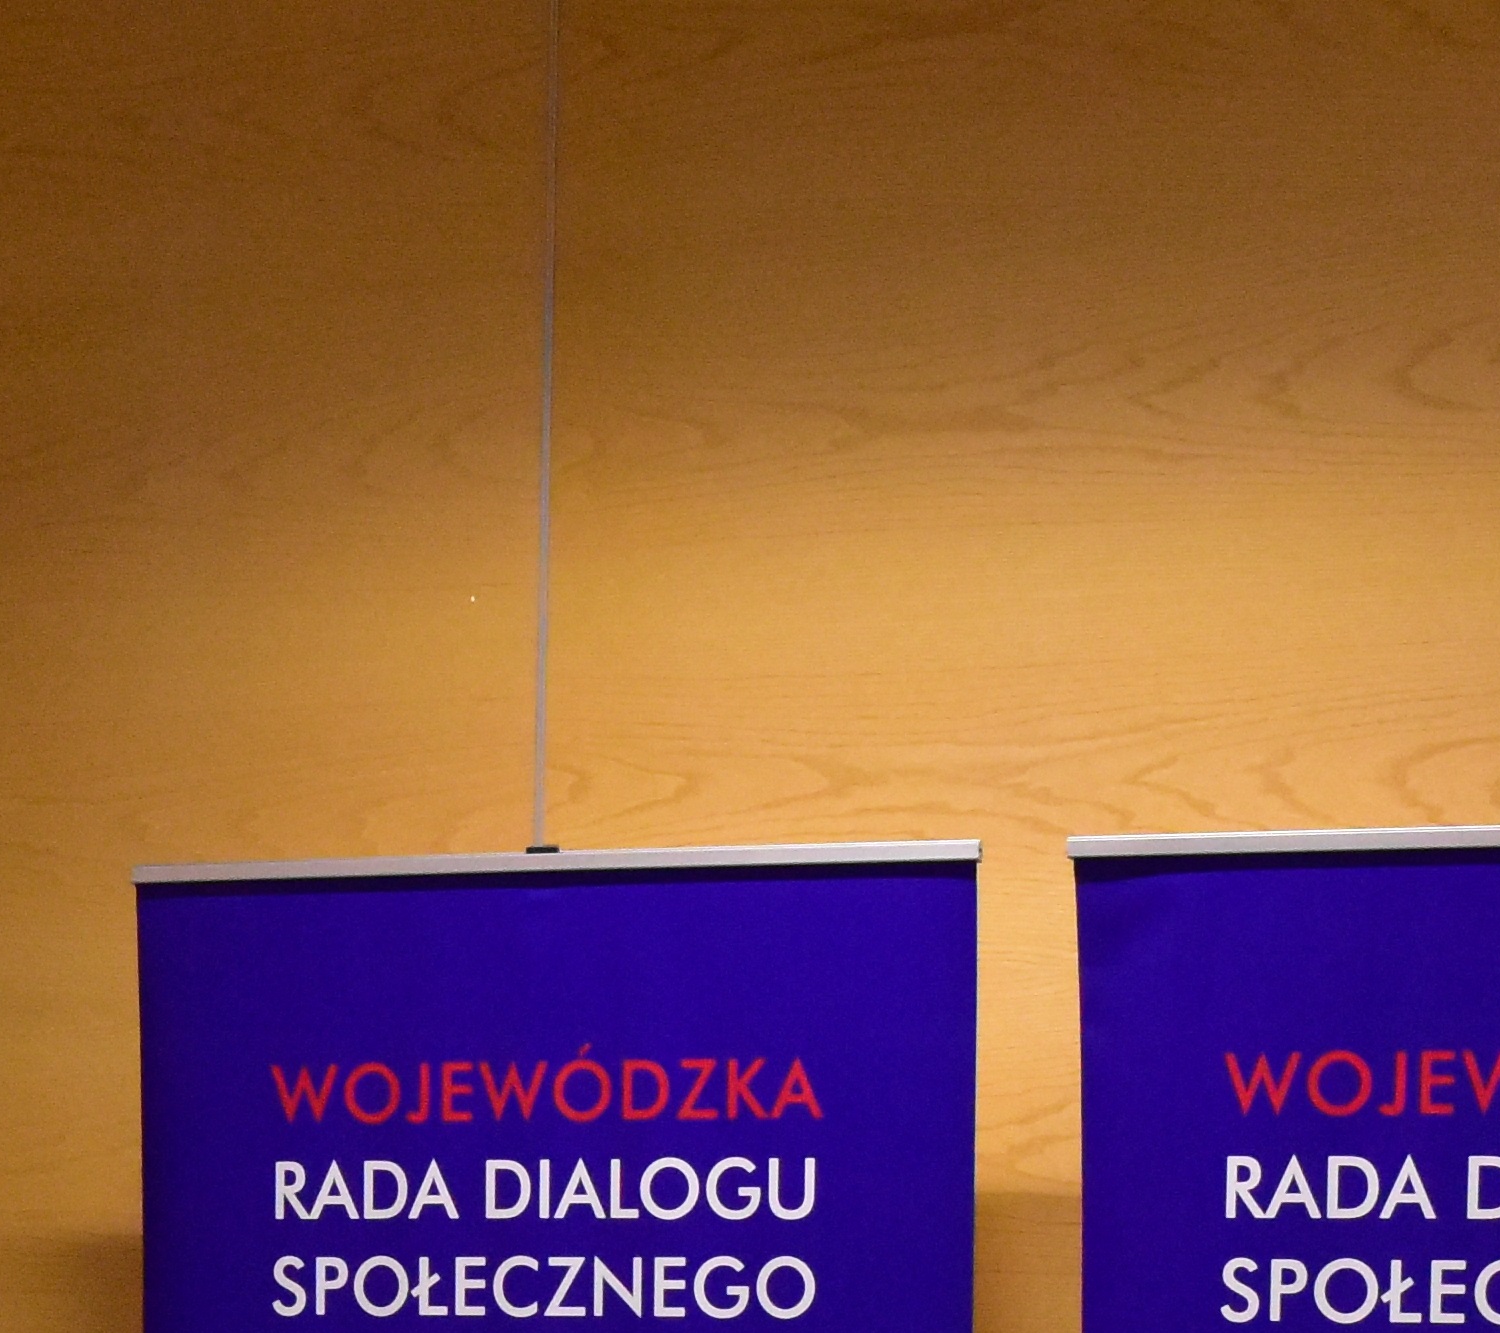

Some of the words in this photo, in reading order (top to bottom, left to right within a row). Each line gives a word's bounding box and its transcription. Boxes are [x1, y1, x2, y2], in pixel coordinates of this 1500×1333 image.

[270, 1044, 825, 1126] WOJEWÓDZKA
[275, 1159, 462, 1221] RADA
[485, 1156, 818, 1222] DIALOGU
[1225, 1154, 1437, 1221] RADA
[272, 1255, 818, 1321] SPOŁECZNEGO
